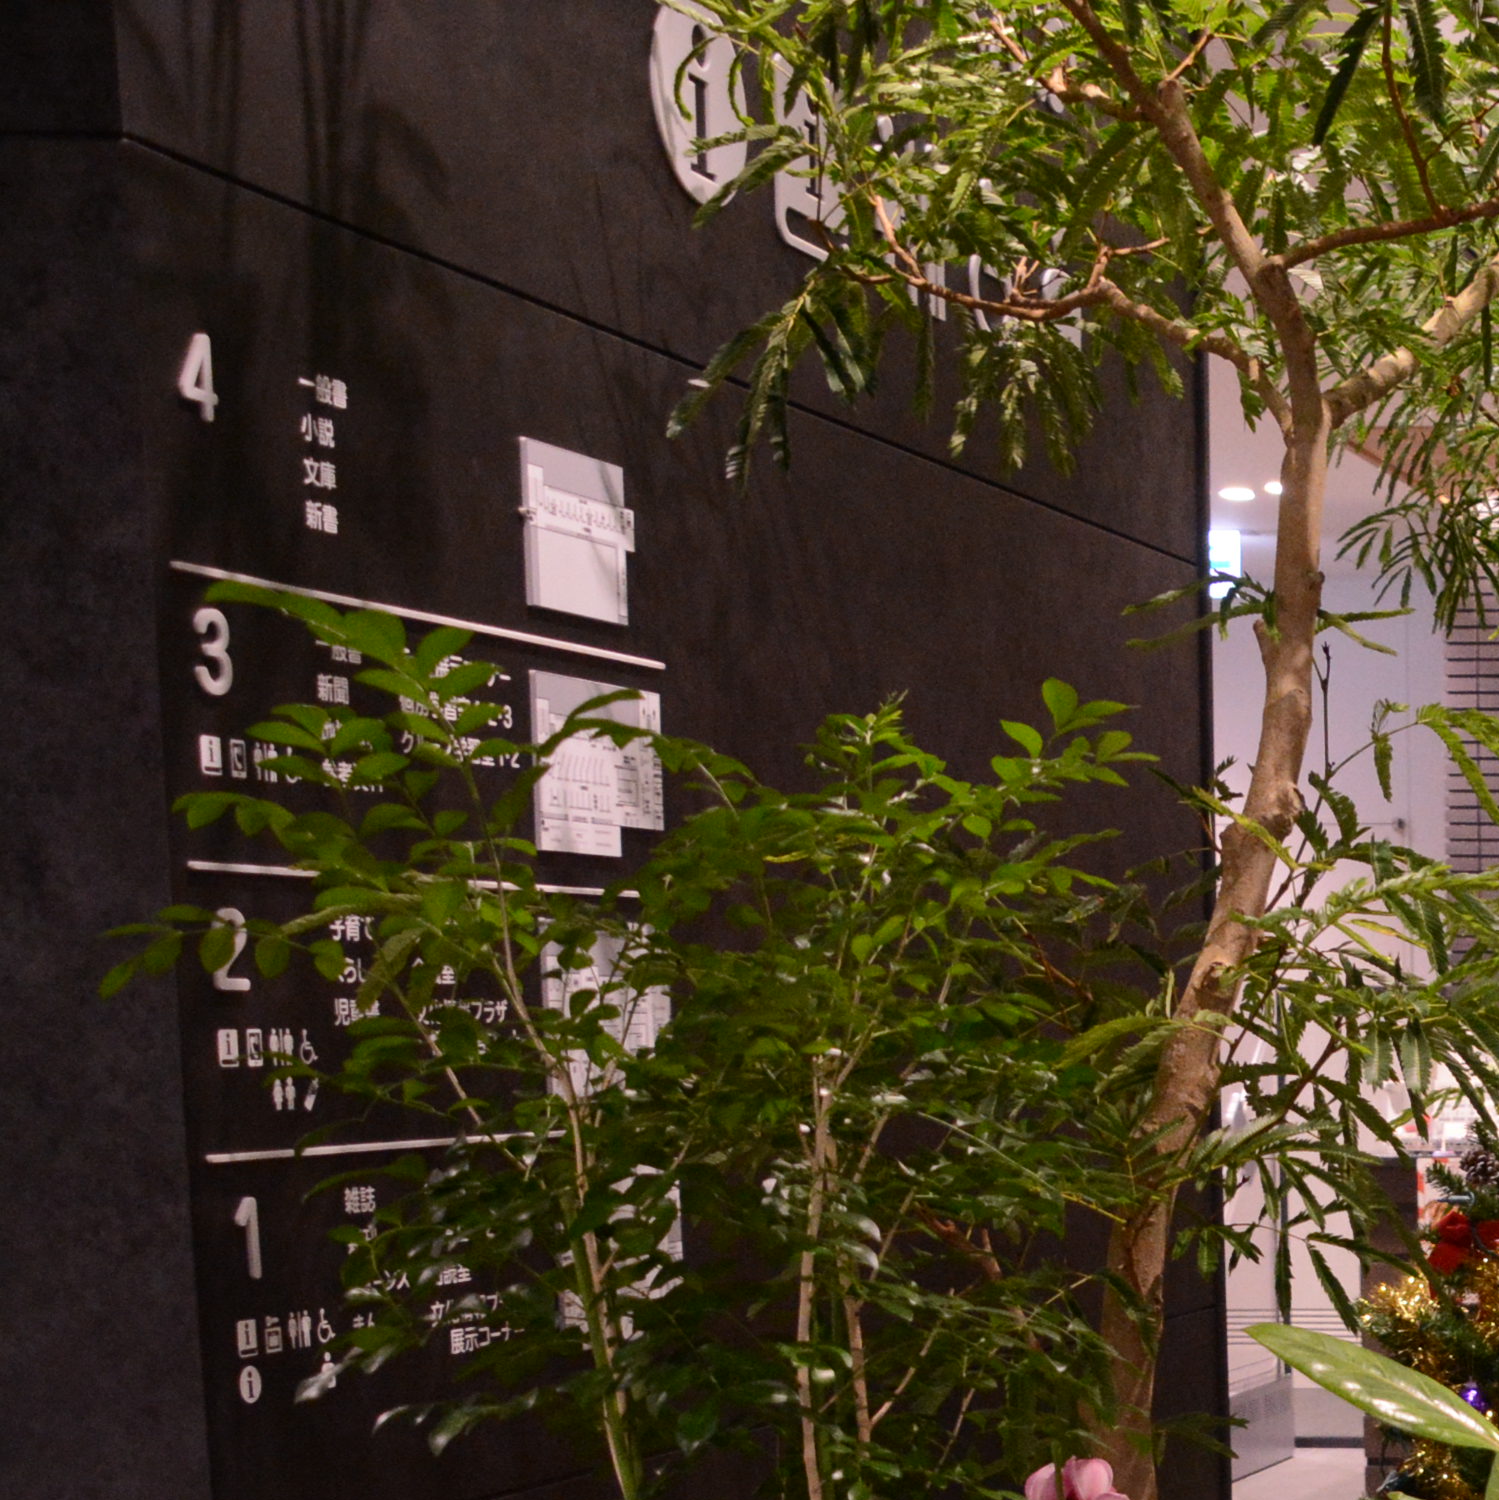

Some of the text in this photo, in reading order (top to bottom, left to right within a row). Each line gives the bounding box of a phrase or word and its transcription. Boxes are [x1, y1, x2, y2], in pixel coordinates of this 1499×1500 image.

[178, 332, 219, 423] 4
[298, 374, 348, 409] 一般書
[300, 413, 335, 448] 小説
[303, 457, 337, 490] 文庫
[305, 500, 339, 534] 新書
[193, 608, 233, 696] 3
[317, 673, 350, 705] 新聞
[211, 907, 250, 991] 2
[344, 1186, 376, 1214] 雑誌
[234, 1196, 262, 1279] 1
[450, 1321, 525, 1355] 展示コーナー
